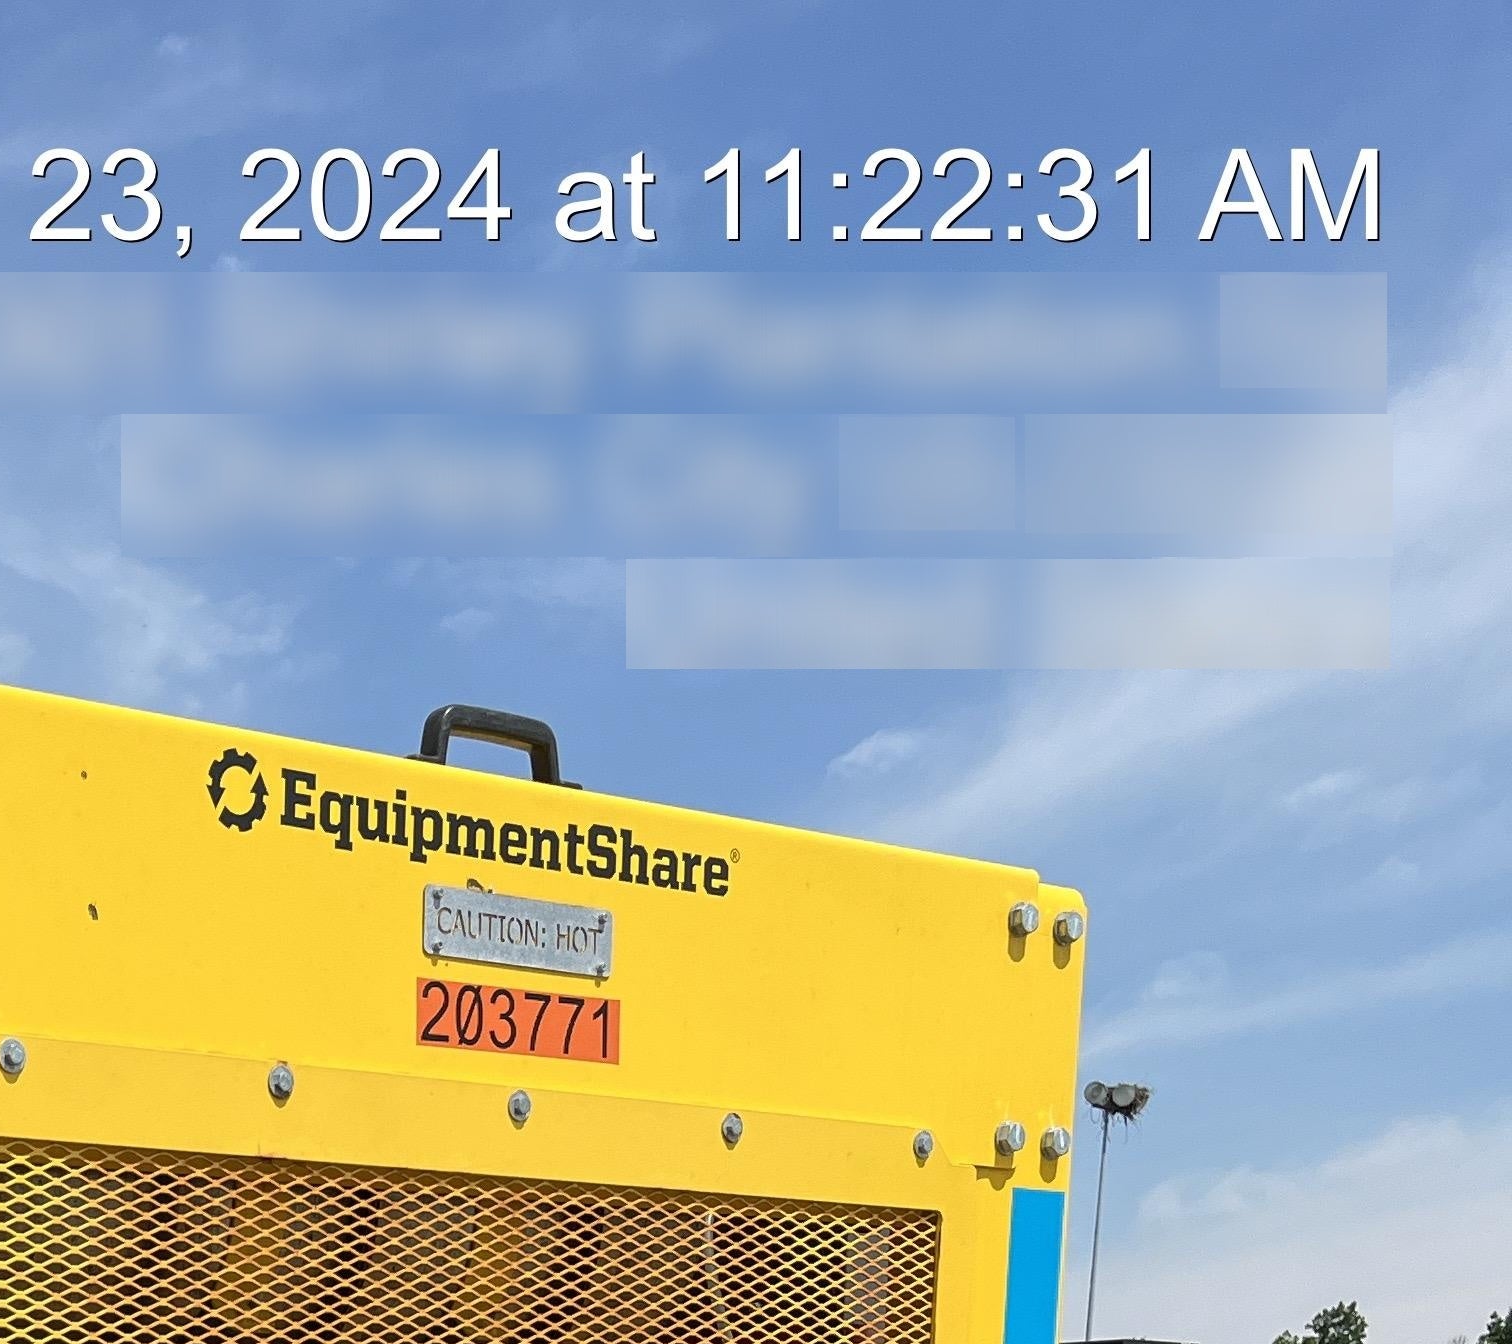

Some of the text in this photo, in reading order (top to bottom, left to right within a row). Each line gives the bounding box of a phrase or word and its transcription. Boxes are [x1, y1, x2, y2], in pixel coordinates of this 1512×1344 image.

[438, 906, 604, 955] CAUTION: HOT
[421, 980, 609, 1059] 203771
